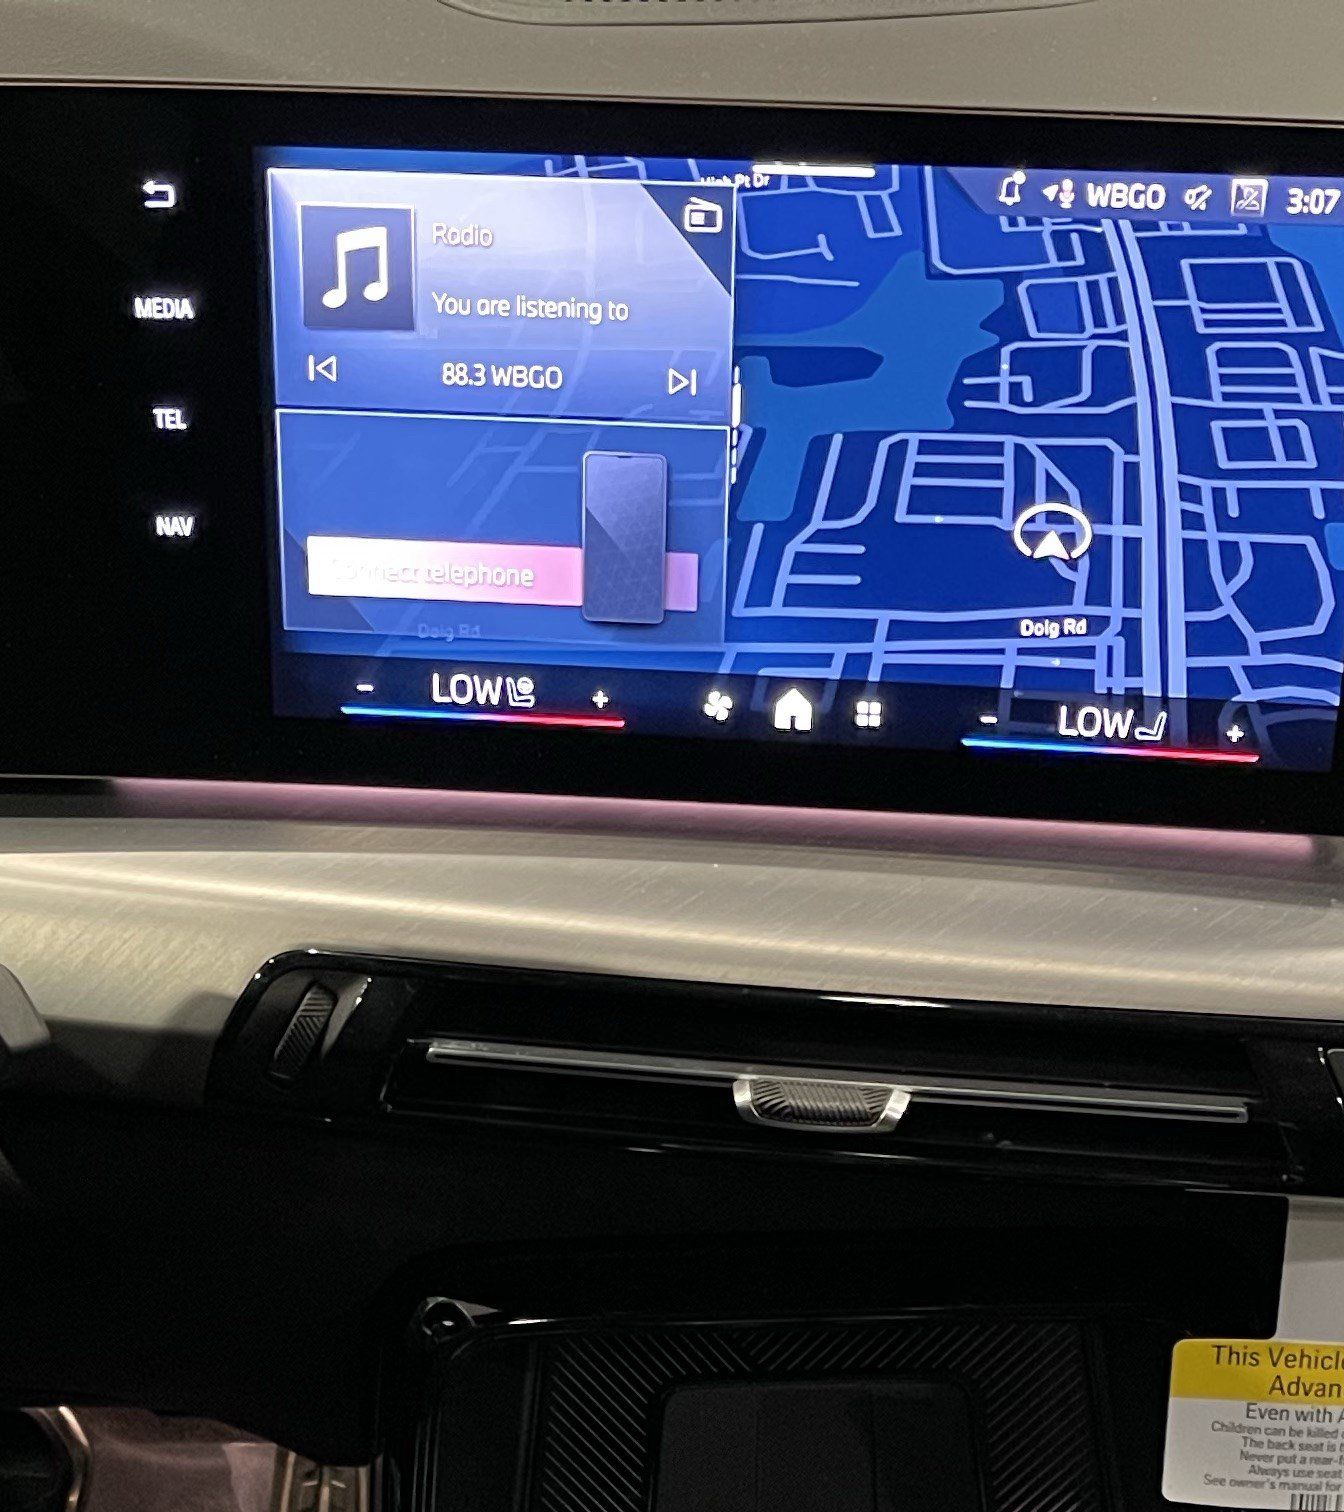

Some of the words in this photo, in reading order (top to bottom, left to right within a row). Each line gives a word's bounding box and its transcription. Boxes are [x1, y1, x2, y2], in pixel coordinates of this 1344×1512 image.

[1087, 181, 1167, 210] WBGO
[1285, 187, 1341, 216] 3:07
[432, 222, 494, 248] Radio
[134, 297, 194, 319] MEDIA
[432, 291, 472, 317] You
[477, 297, 511, 318] are
[517, 294, 602, 326] listening
[607, 298, 630, 322] to
[441, 361, 486, 388] 88.3
[492, 365, 563, 390] WBGO
[152, 408, 188, 430] TEL
[155, 515, 194, 537] NAV
[424, 563, 534, 588] telephone
[1063, 617, 1087, 635] Rd
[432, 672, 504, 707] LOW
[1058, 705, 1136, 739] LOW
[1212, 1345, 1261, 1368] This
[1246, 1403, 1289, 1421] Even
[1295, 1406, 1332, 1423] with
[1211, 1420, 1262, 1435] Children
[1264, 1426, 1286, 1437] can
[1288, 1426, 1304, 1438] be
[1306, 1427, 1339, 1439] killed
[1242, 1436, 1264, 1449] The
[1267, 1439, 1294, 1451] back
[1299, 1441, 1324, 1451] seat
[1327, 1441, 1336, 1452] is
[1240, 1450, 1275, 1463] Never
[1277, 1452, 1297, 1465] put
[1203, 1473, 1226, 1486] See
[1229, 1478, 1276, 1490] owner's
[1279, 1479, 1322, 1492] manual
[1325, 1480, 1341, 1492] for
[1248, 1464, 1290, 1478] Always
[1293, 1467, 1313, 1478] use
[1316, 1468, 1342, 1479] seat
